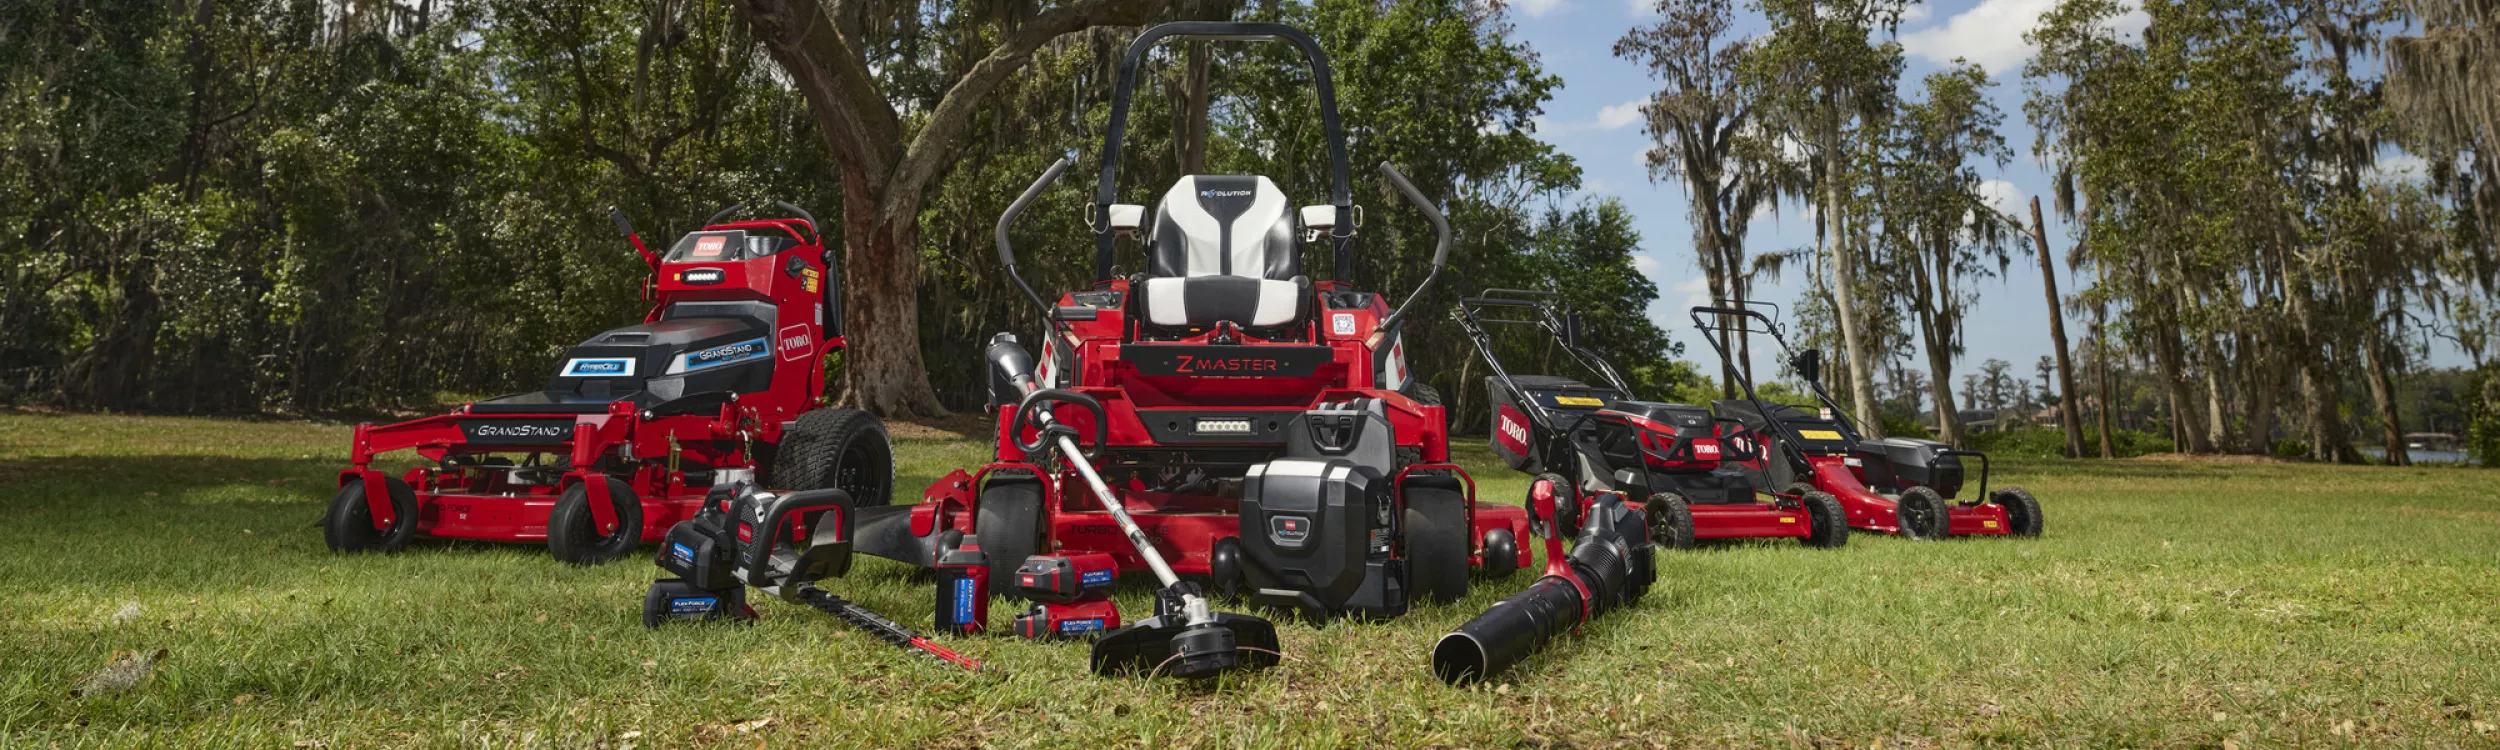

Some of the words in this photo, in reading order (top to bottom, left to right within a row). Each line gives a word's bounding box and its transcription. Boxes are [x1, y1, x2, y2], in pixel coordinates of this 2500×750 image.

[698, 241, 722, 251] TORO
[784, 334, 809, 350] TORO
[478, 425, 560, 436] GRANDSTAND
[1501, 414, 1527, 444] TORO
[1695, 445, 1719, 453] TORO
[1071, 524, 1118, 535] TURBO
